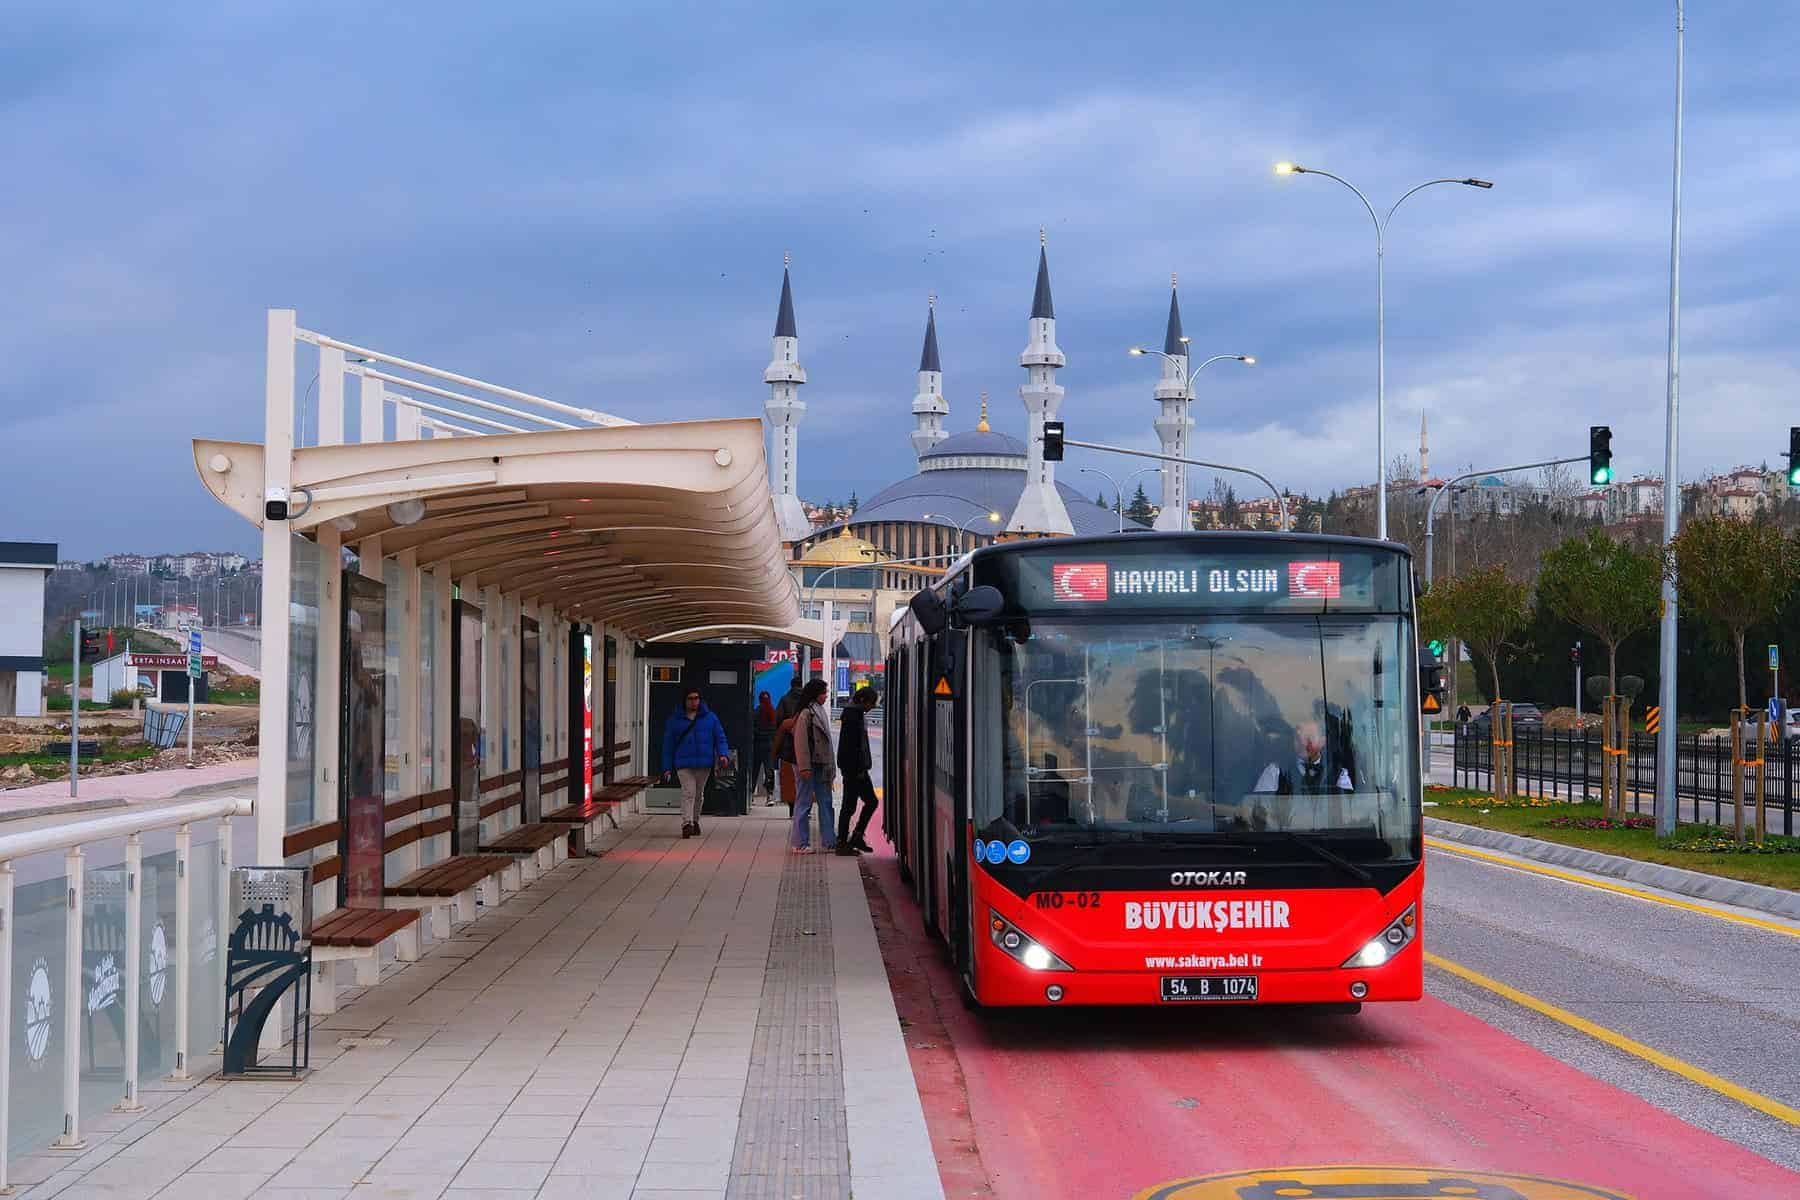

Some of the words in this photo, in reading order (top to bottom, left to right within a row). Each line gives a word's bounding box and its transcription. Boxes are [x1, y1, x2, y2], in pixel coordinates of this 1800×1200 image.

[1114, 569, 1198, 594] HAYIRLI
[1209, 569, 1278, 593] OLSUN
[1170, 871, 1247, 886] OTOKAR
[1125, 899, 1290, 933] BÜYÜKŞEHİR
[1171, 979, 1188, 995] 54
[1200, 979, 1209, 995] B
[1223, 978, 1254, 995] 1074
